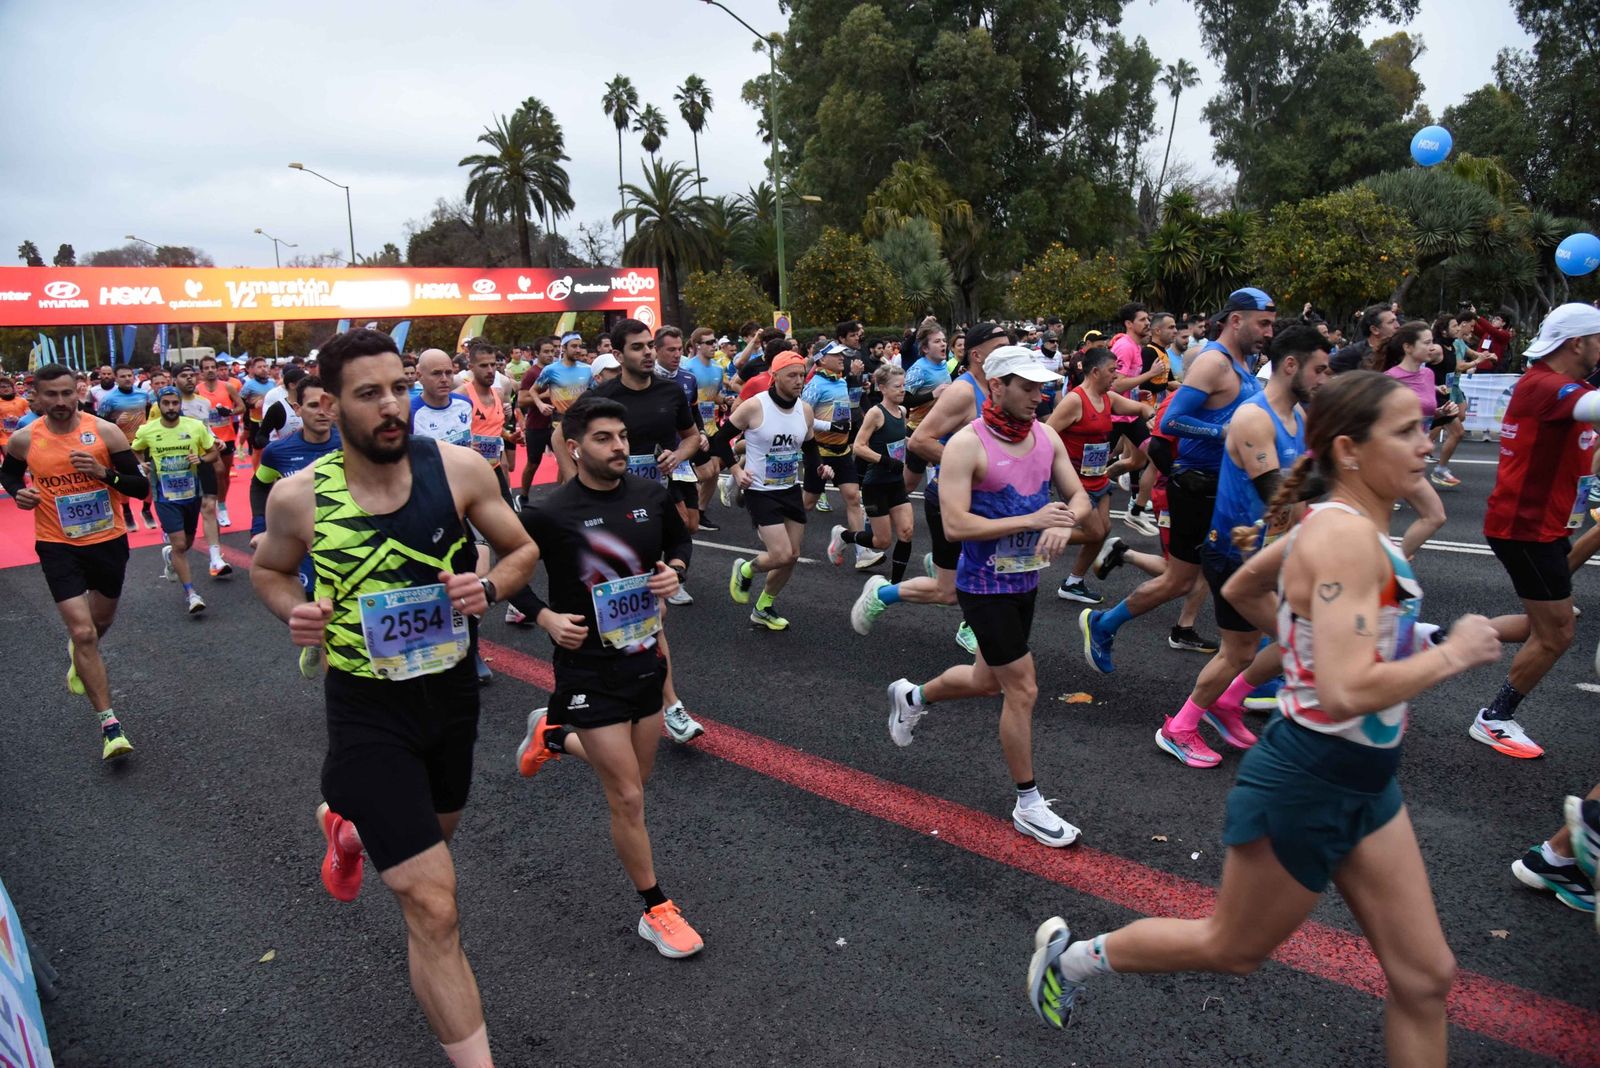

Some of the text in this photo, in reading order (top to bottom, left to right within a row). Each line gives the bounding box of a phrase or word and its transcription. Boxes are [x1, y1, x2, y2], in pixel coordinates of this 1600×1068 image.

[99, 287, 165, 305] HOKA
[414, 283, 462, 299] HOKA
[38, 300, 90, 309] HYUNDAI
[168, 479, 189, 488] 3255
[66, 502, 101, 519] 3631
[607, 591, 650, 619] 3605
[380, 605, 444, 642] 2554
